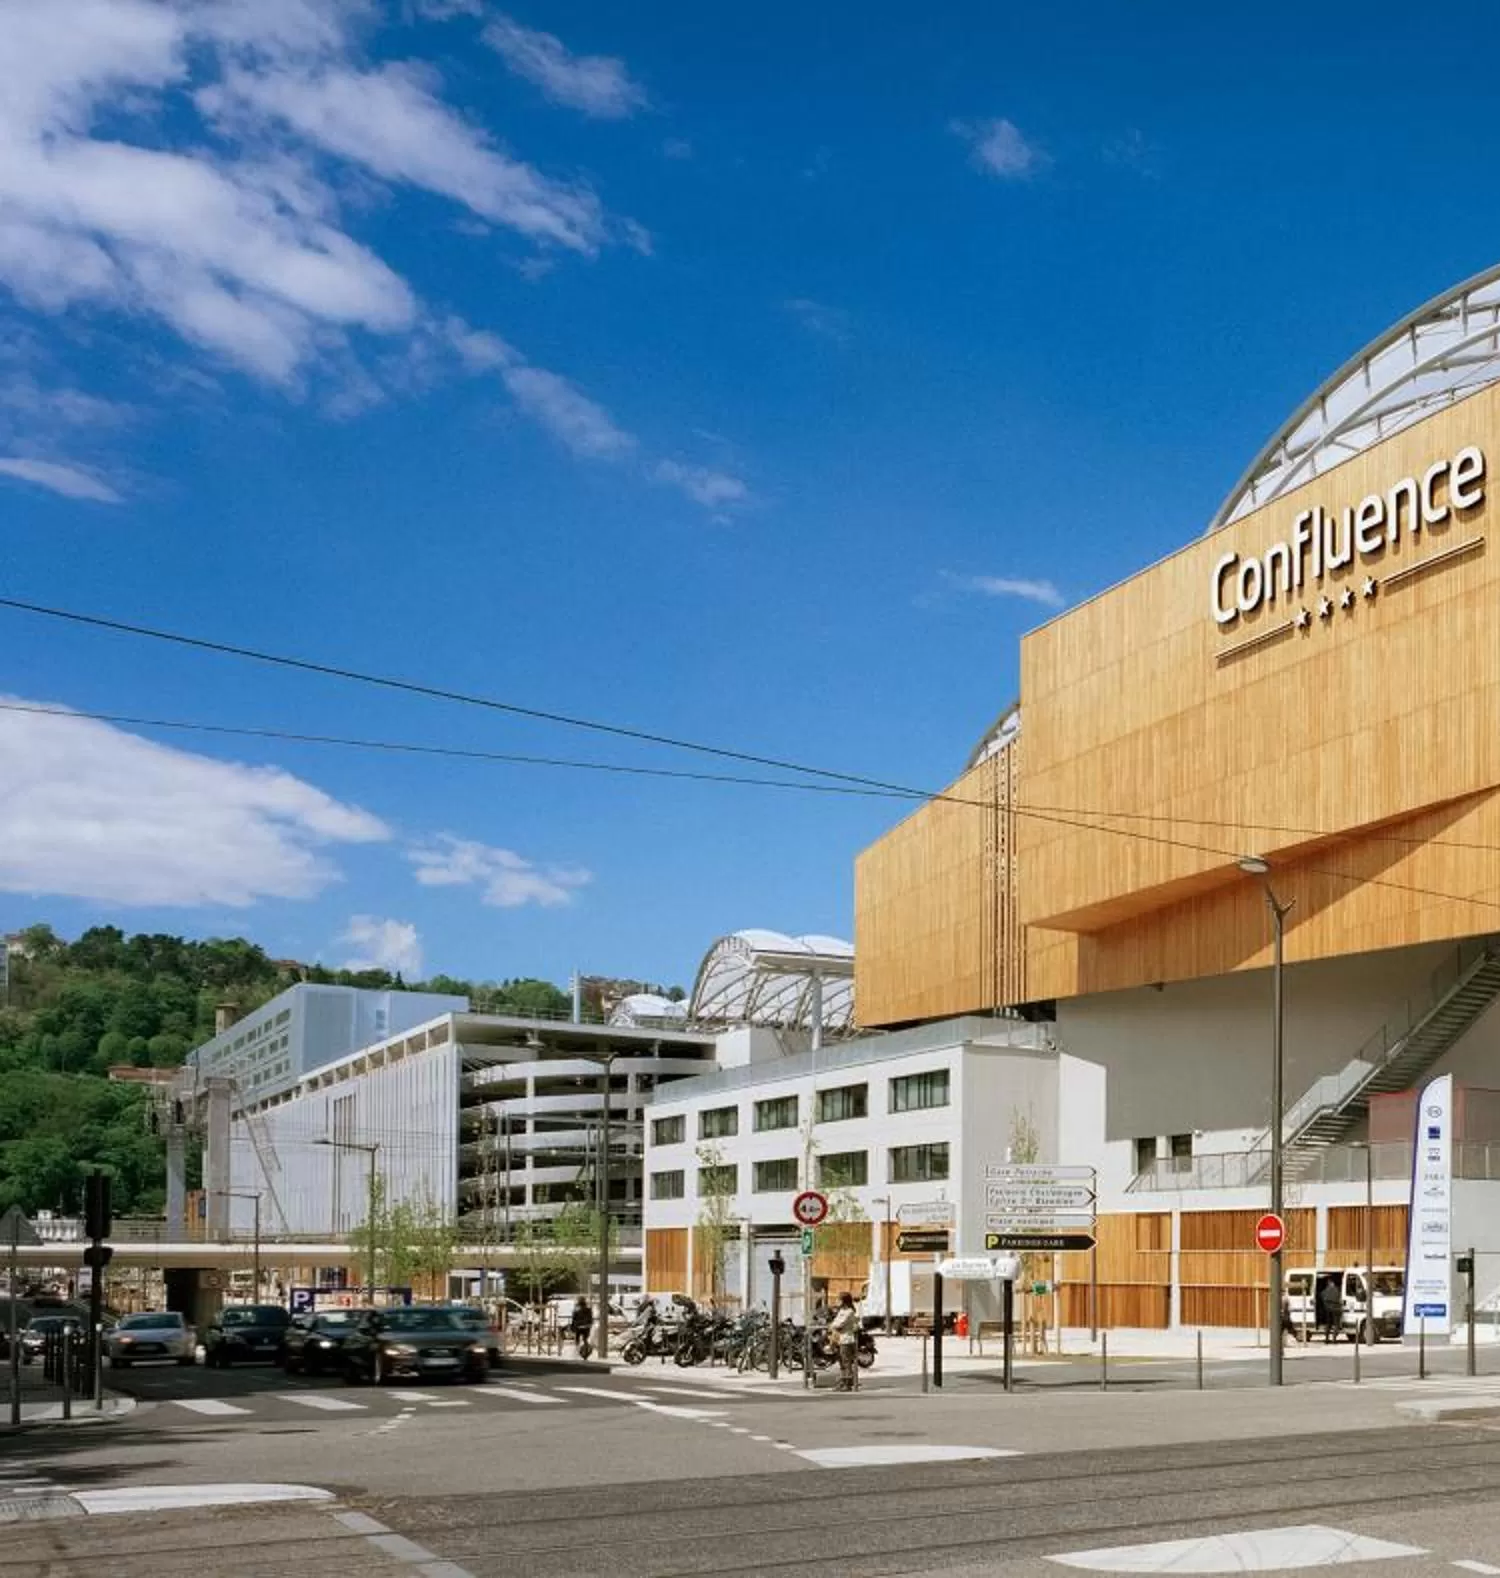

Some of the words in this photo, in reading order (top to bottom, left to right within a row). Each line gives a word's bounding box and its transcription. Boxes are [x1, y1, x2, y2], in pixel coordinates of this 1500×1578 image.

[1211, 446, 1484, 624] Confluence
[987, 1235, 1000, 1249] P
[293, 1290, 311, 1309] P
